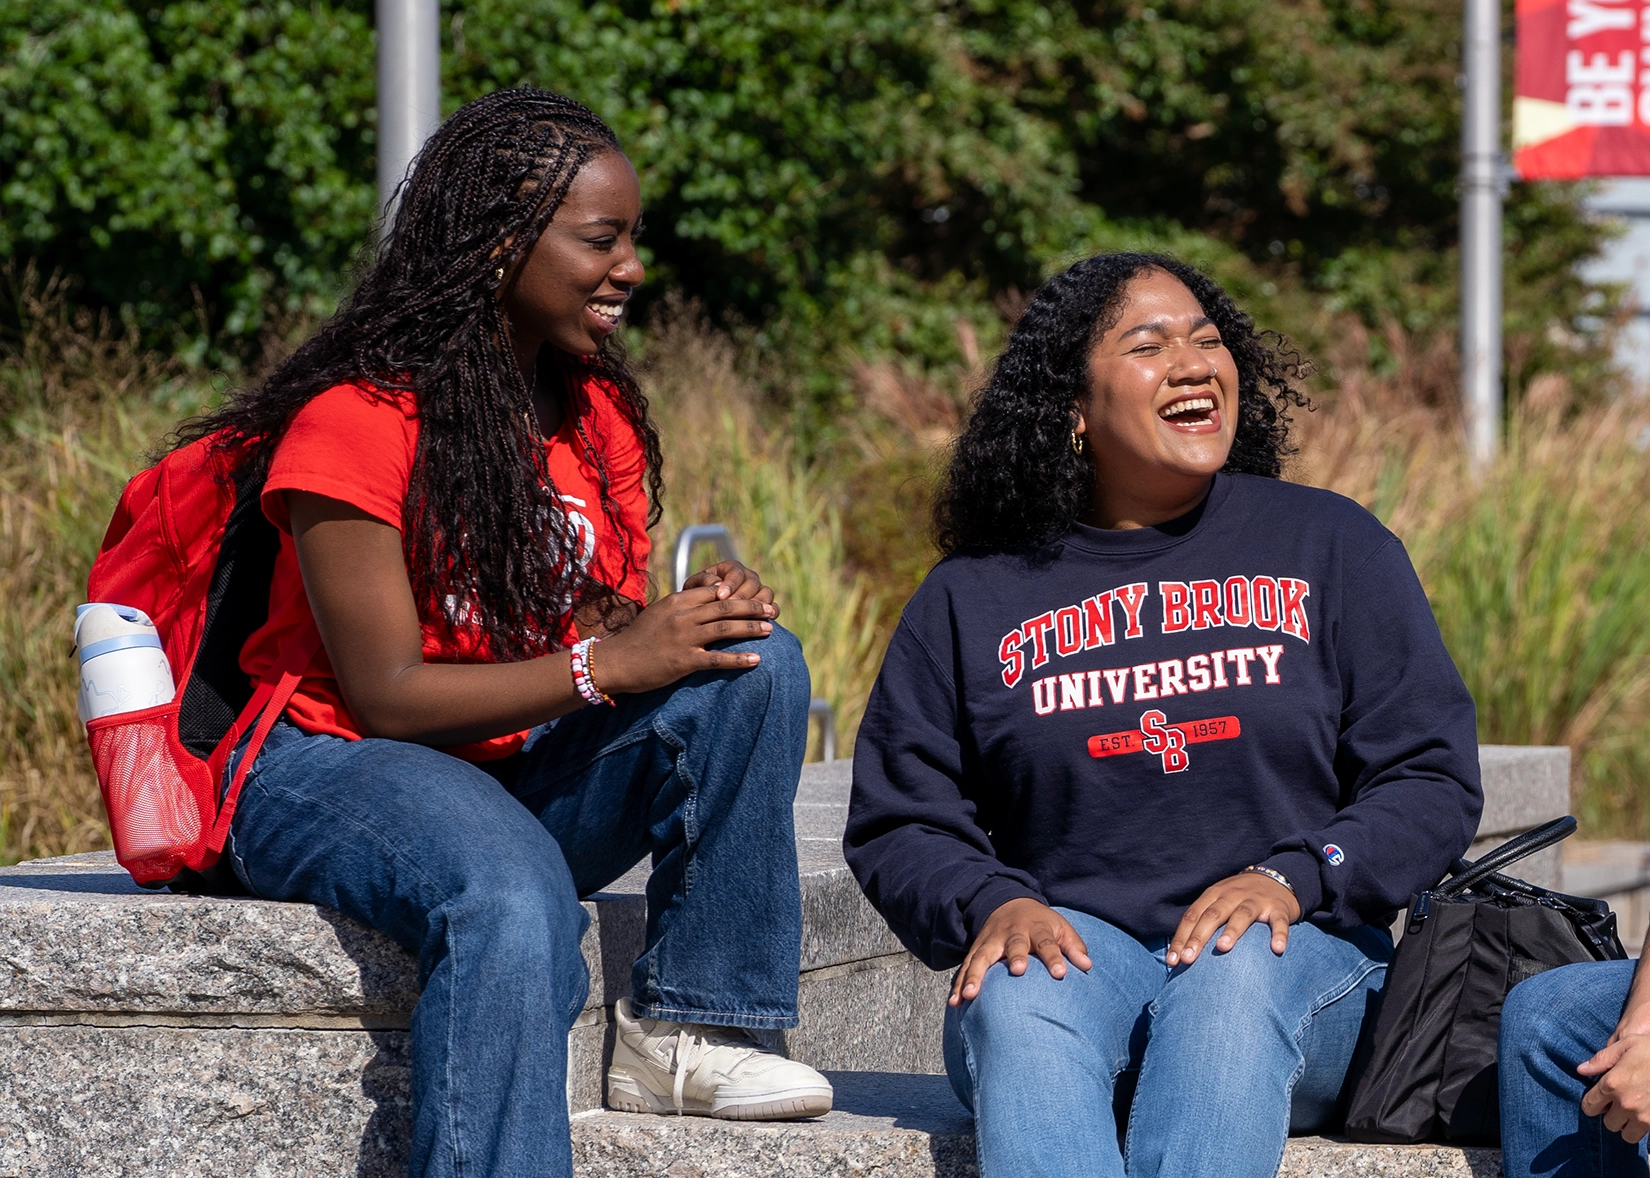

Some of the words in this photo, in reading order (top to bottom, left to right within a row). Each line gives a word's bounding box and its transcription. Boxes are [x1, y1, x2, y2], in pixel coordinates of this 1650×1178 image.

[1566, 50, 1635, 126] BE
[999, 582, 1148, 689] STONY
[1158, 575, 1310, 645] BROOK
[1031, 644, 1284, 716] UNIVERSITY
[1192, 721, 1227, 738] 1957
